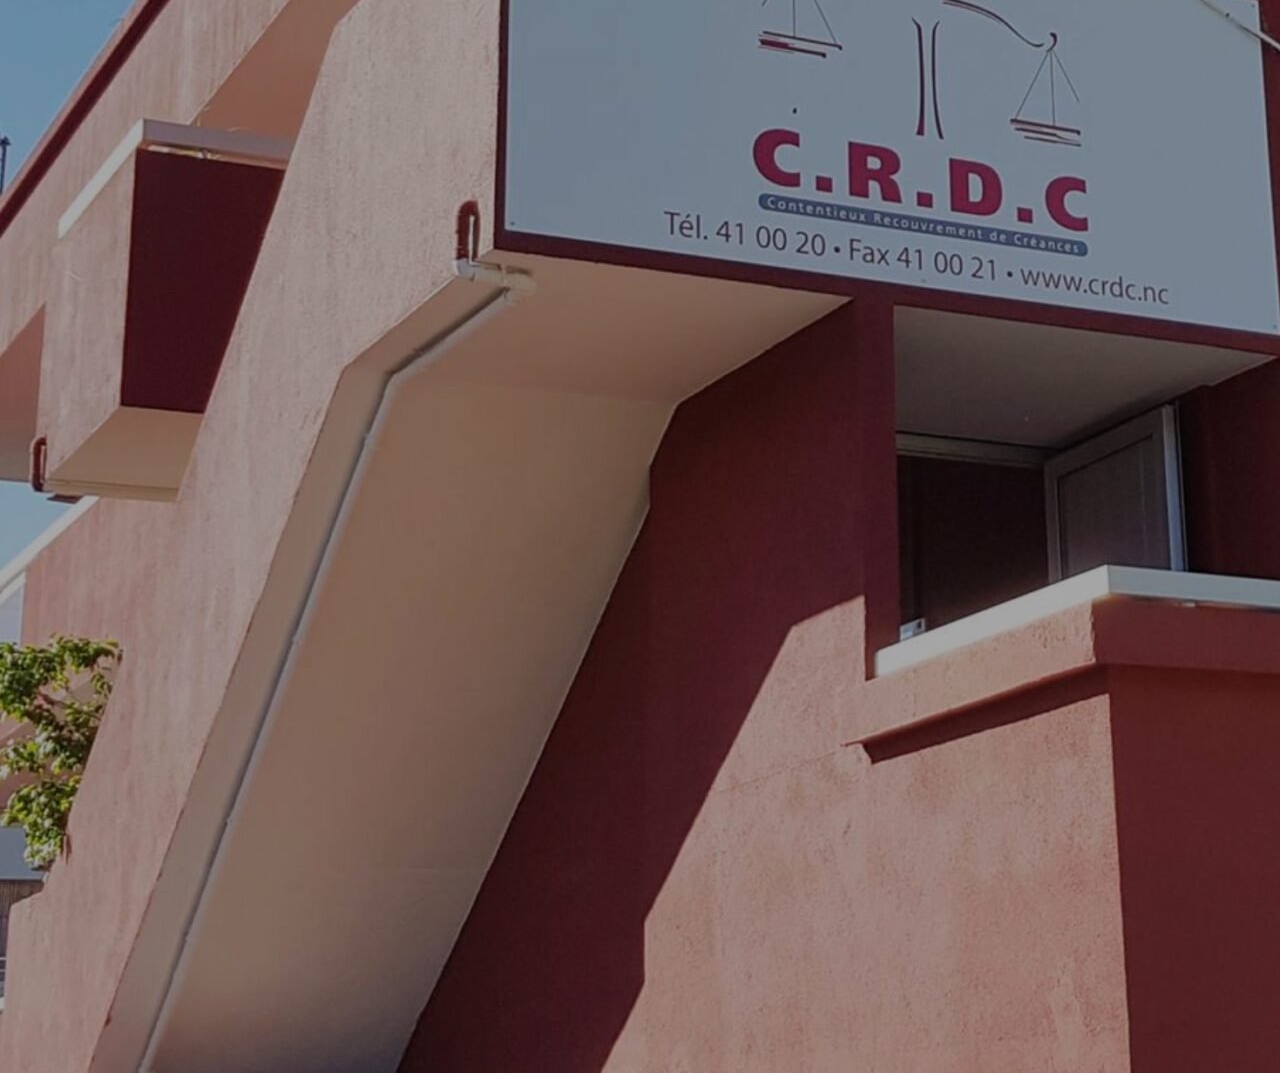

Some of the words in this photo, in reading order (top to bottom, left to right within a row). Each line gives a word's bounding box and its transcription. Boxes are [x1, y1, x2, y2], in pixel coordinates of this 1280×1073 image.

[752, 128, 1090, 232] C.R.D.C
[767, 196, 867, 222] Contentieux
[873, 213, 983, 241] Recouvrement
[989, 227, 1007, 243] de
[1013, 233, 1080, 254] Créances
[663, 211, 708, 241] Tél.
[716, 220, 744, 245] 41
[756, 225, 787, 251] 00
[795, 230, 826, 256] 20
[849, 238, 890, 267] Fax
[896, 247, 923, 271] 41
[934, 251, 963, 276] 00
[970, 256, 997, 281] 21
[1020, 267, 1170, 305] www.crdc.nc
